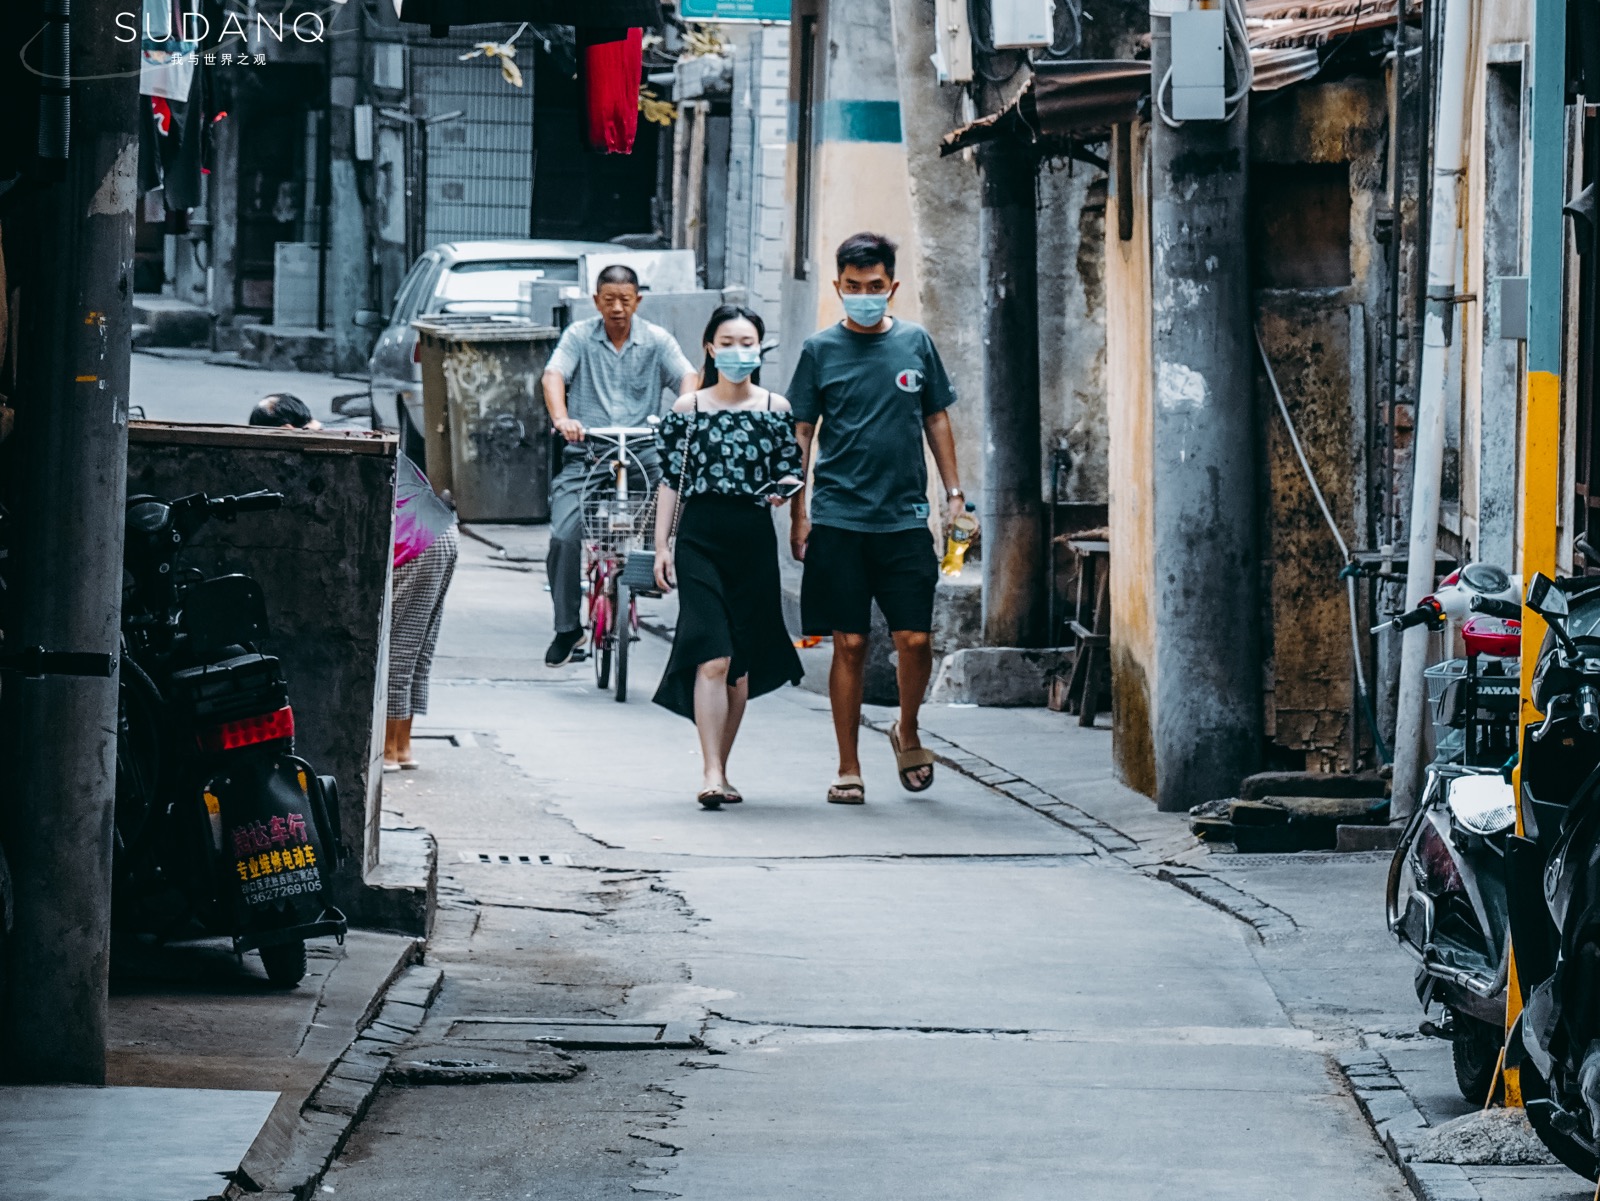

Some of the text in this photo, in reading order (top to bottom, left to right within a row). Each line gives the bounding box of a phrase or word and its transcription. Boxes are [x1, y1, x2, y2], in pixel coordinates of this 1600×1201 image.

[236, 844, 316, 881] 专业维修电动车
[245, 881, 323, 905] 13627269105
